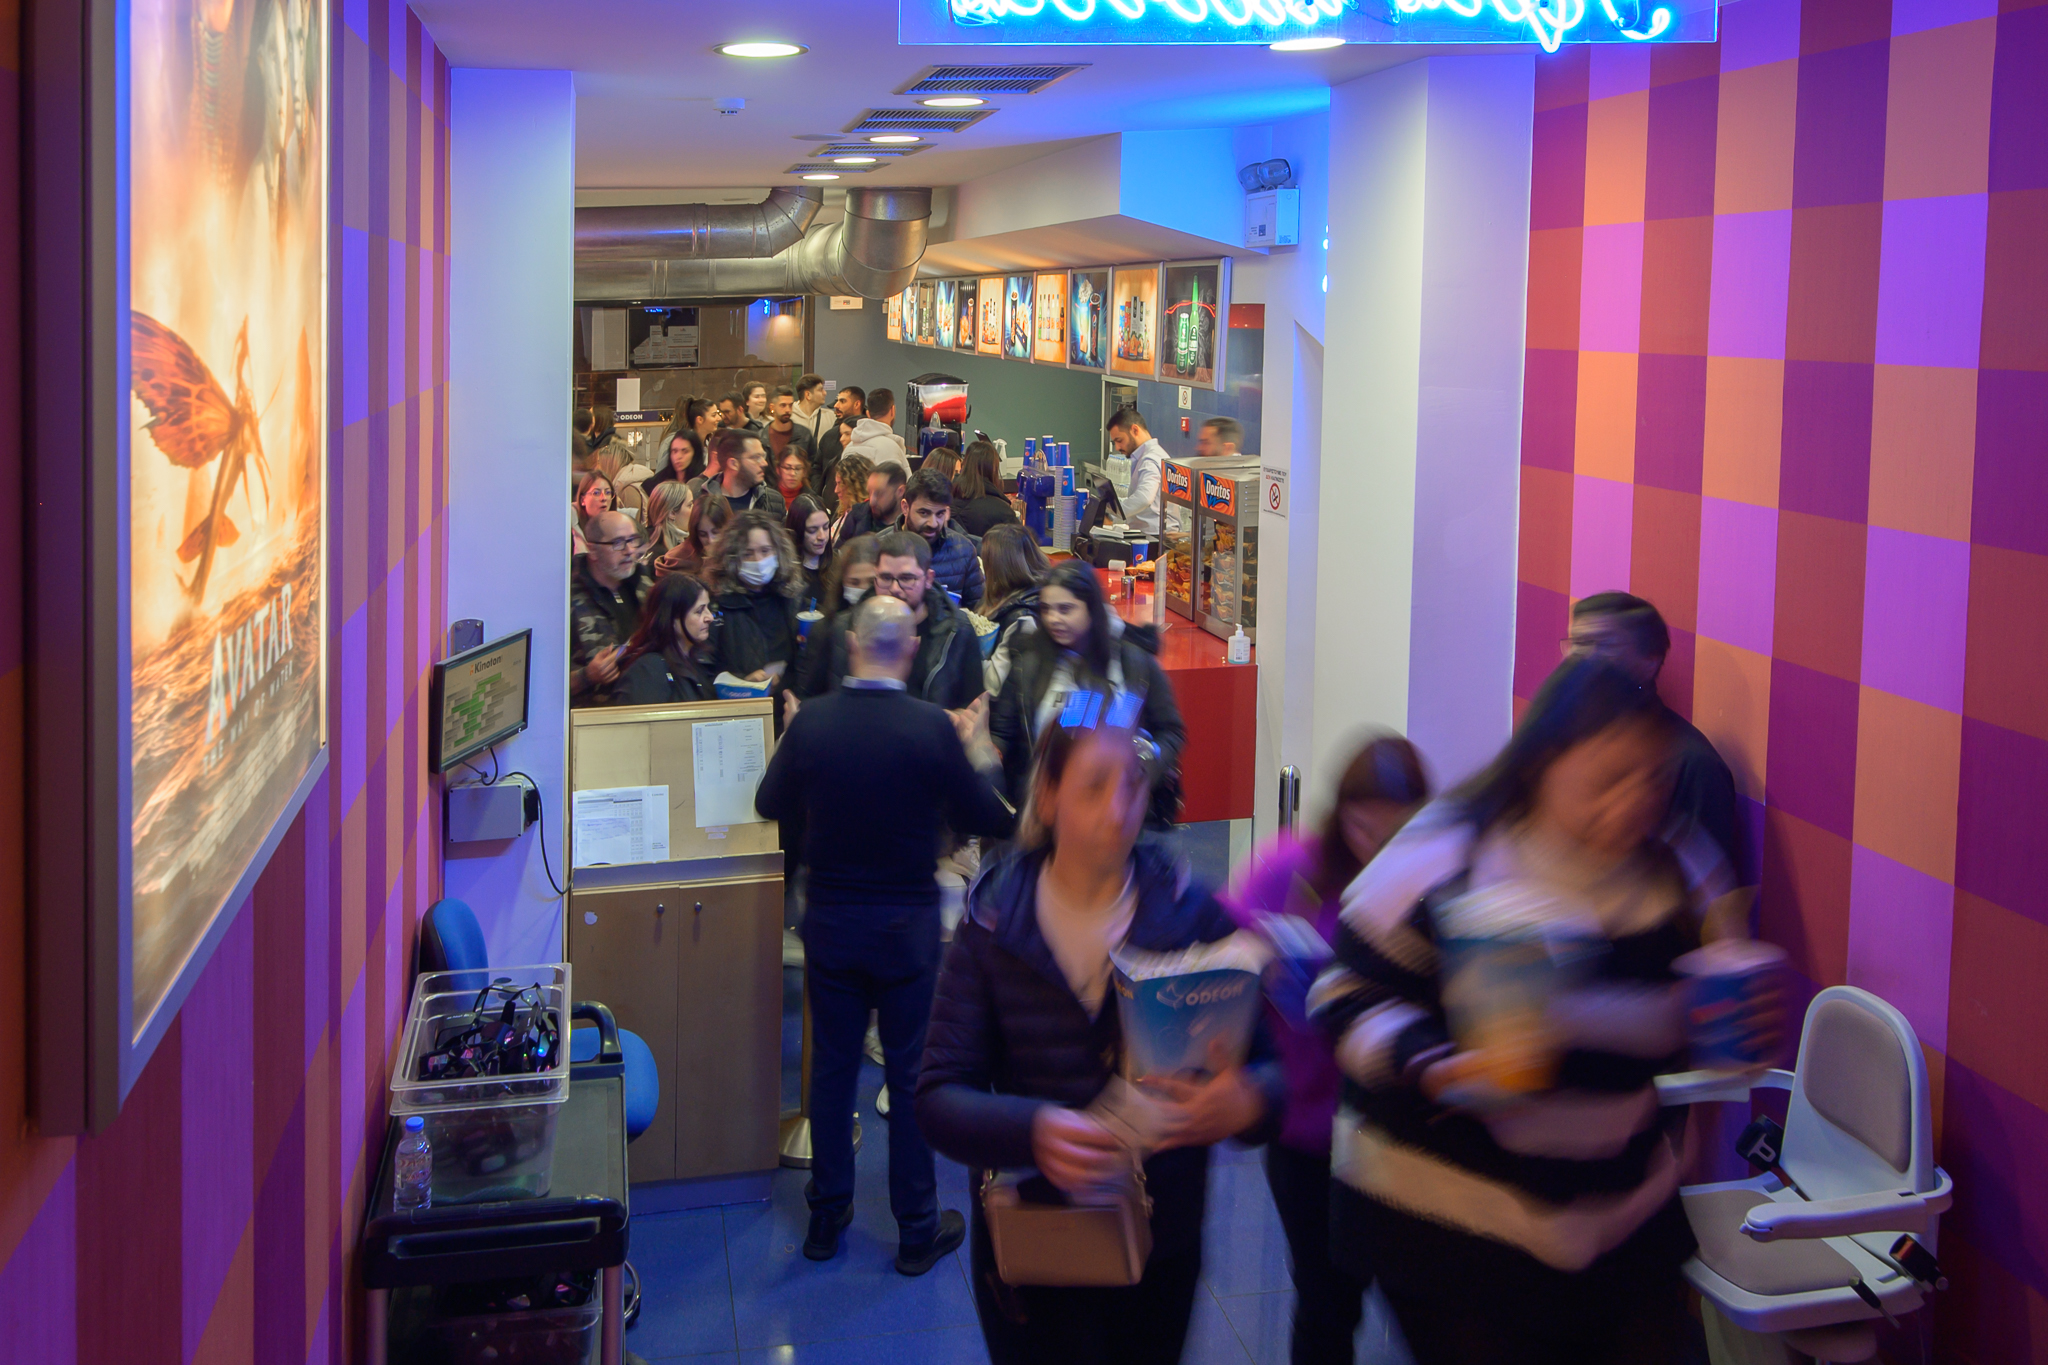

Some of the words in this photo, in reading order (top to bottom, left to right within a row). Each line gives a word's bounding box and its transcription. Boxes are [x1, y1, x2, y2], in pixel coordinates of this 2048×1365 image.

[1167, 468, 1188, 488] Doritos
[1206, 479, 1231, 500] Doritos
[205, 582, 293, 744] AVATAR
[474, 656, 502, 673] Kinoton
[253, 692, 266, 717] OF
[1185, 982, 1245, 1006] ODEON
